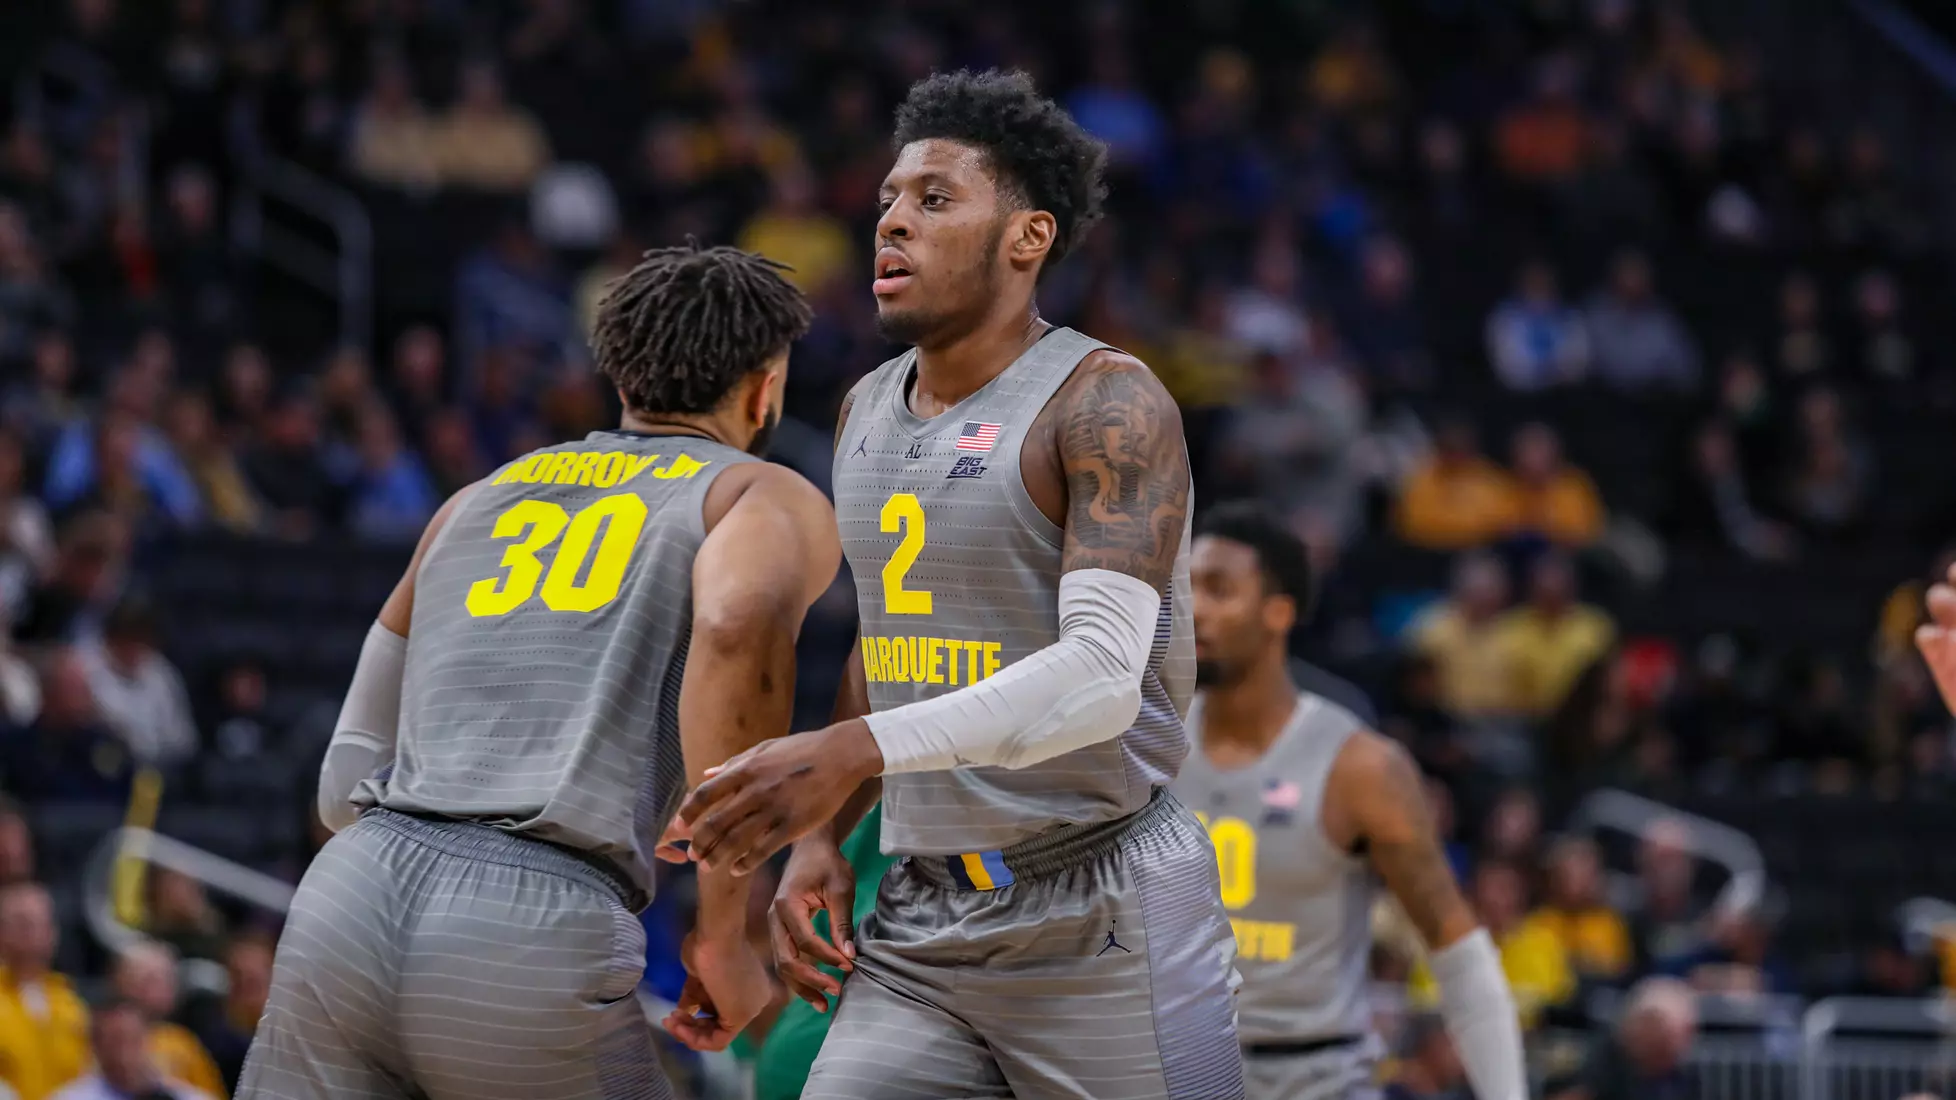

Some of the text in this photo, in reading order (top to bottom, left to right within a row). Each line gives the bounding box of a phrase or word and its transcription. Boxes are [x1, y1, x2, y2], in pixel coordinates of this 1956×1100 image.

[905, 444, 922, 459] AL
[950, 466, 987, 476] EAST
[955, 456, 983, 466] BIG
[464, 492, 649, 617] 30
[880, 493, 933, 615] 2
[1193, 811, 1257, 910] 0
